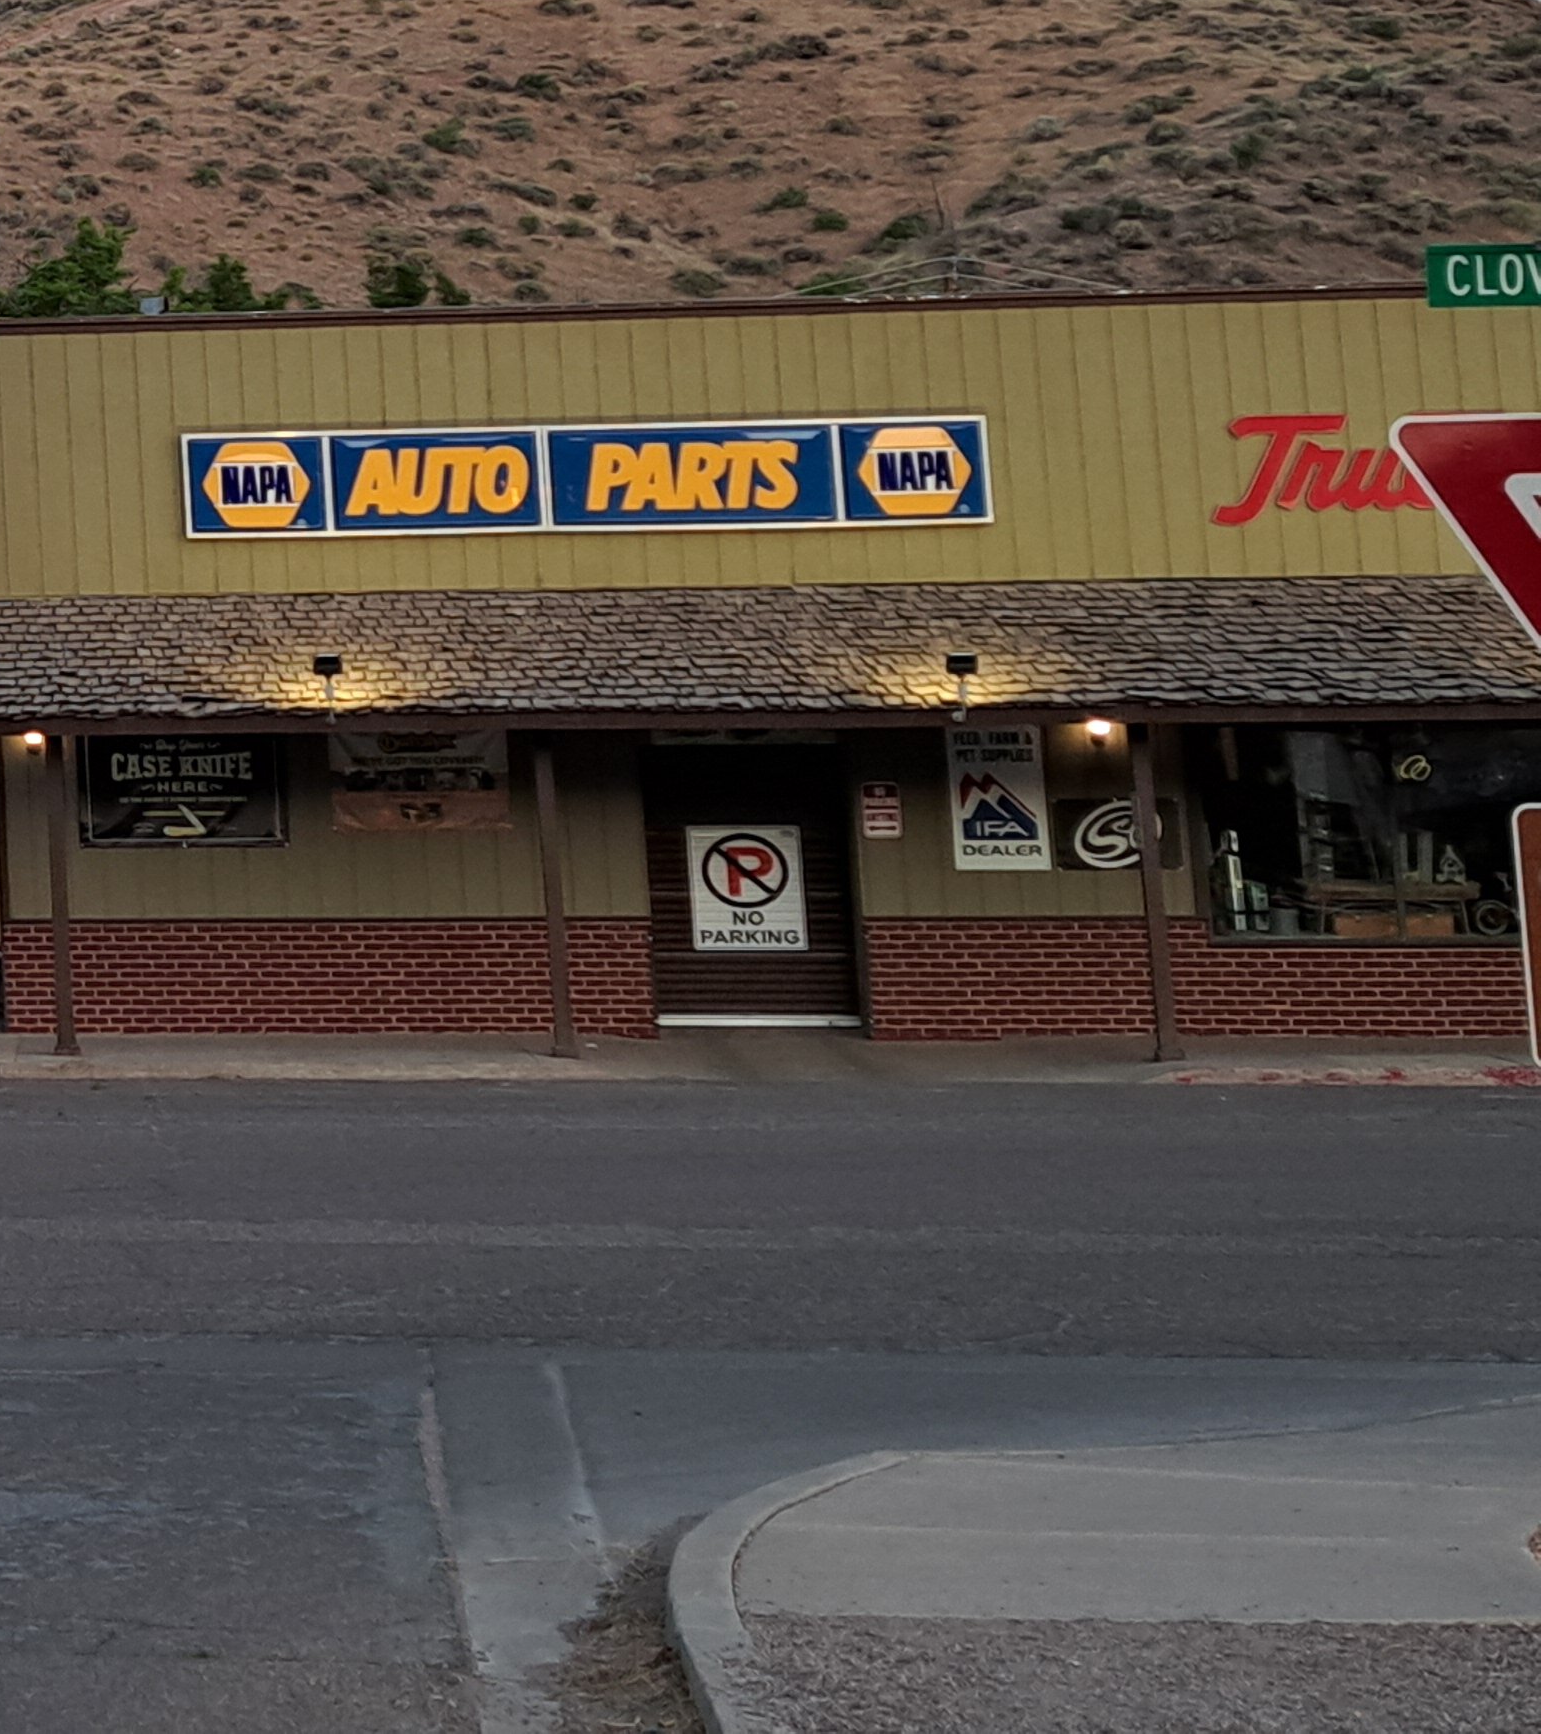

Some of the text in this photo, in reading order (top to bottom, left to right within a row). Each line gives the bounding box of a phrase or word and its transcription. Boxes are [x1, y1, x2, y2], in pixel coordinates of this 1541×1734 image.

[343, 440, 800, 517] AUTO PARTS
[877, 450, 955, 492] NAPA
[220, 464, 294, 505] NAPA
[111, 751, 254, 782] CASE KNIFE
[156, 780, 210, 794] HERE
[974, 820, 1031, 838] IFA
[962, 844, 1043, 857] DEALER
[732, 910, 766, 926] NO
[700, 929, 801, 945] PARKING
